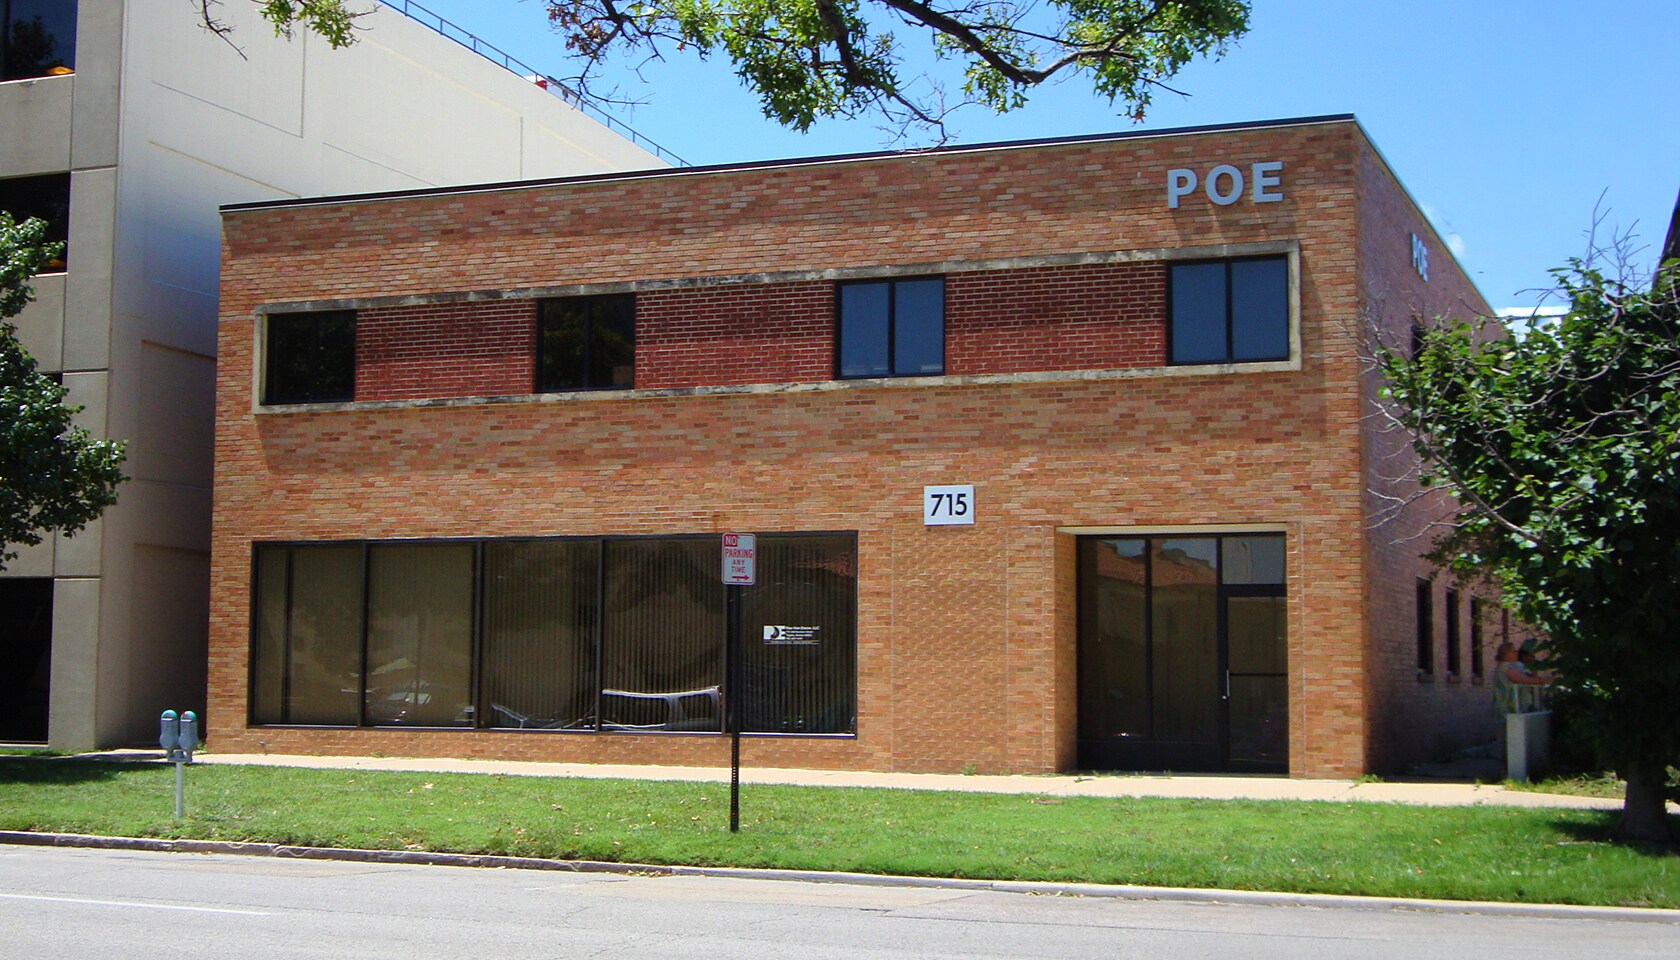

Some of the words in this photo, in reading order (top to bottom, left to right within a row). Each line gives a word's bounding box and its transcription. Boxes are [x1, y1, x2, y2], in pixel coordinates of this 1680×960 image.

[1167, 161, 1284, 209] POE
[930, 493, 968, 517] 715
[725, 535, 737, 546] NO
[725, 548, 753, 558] PARKING
